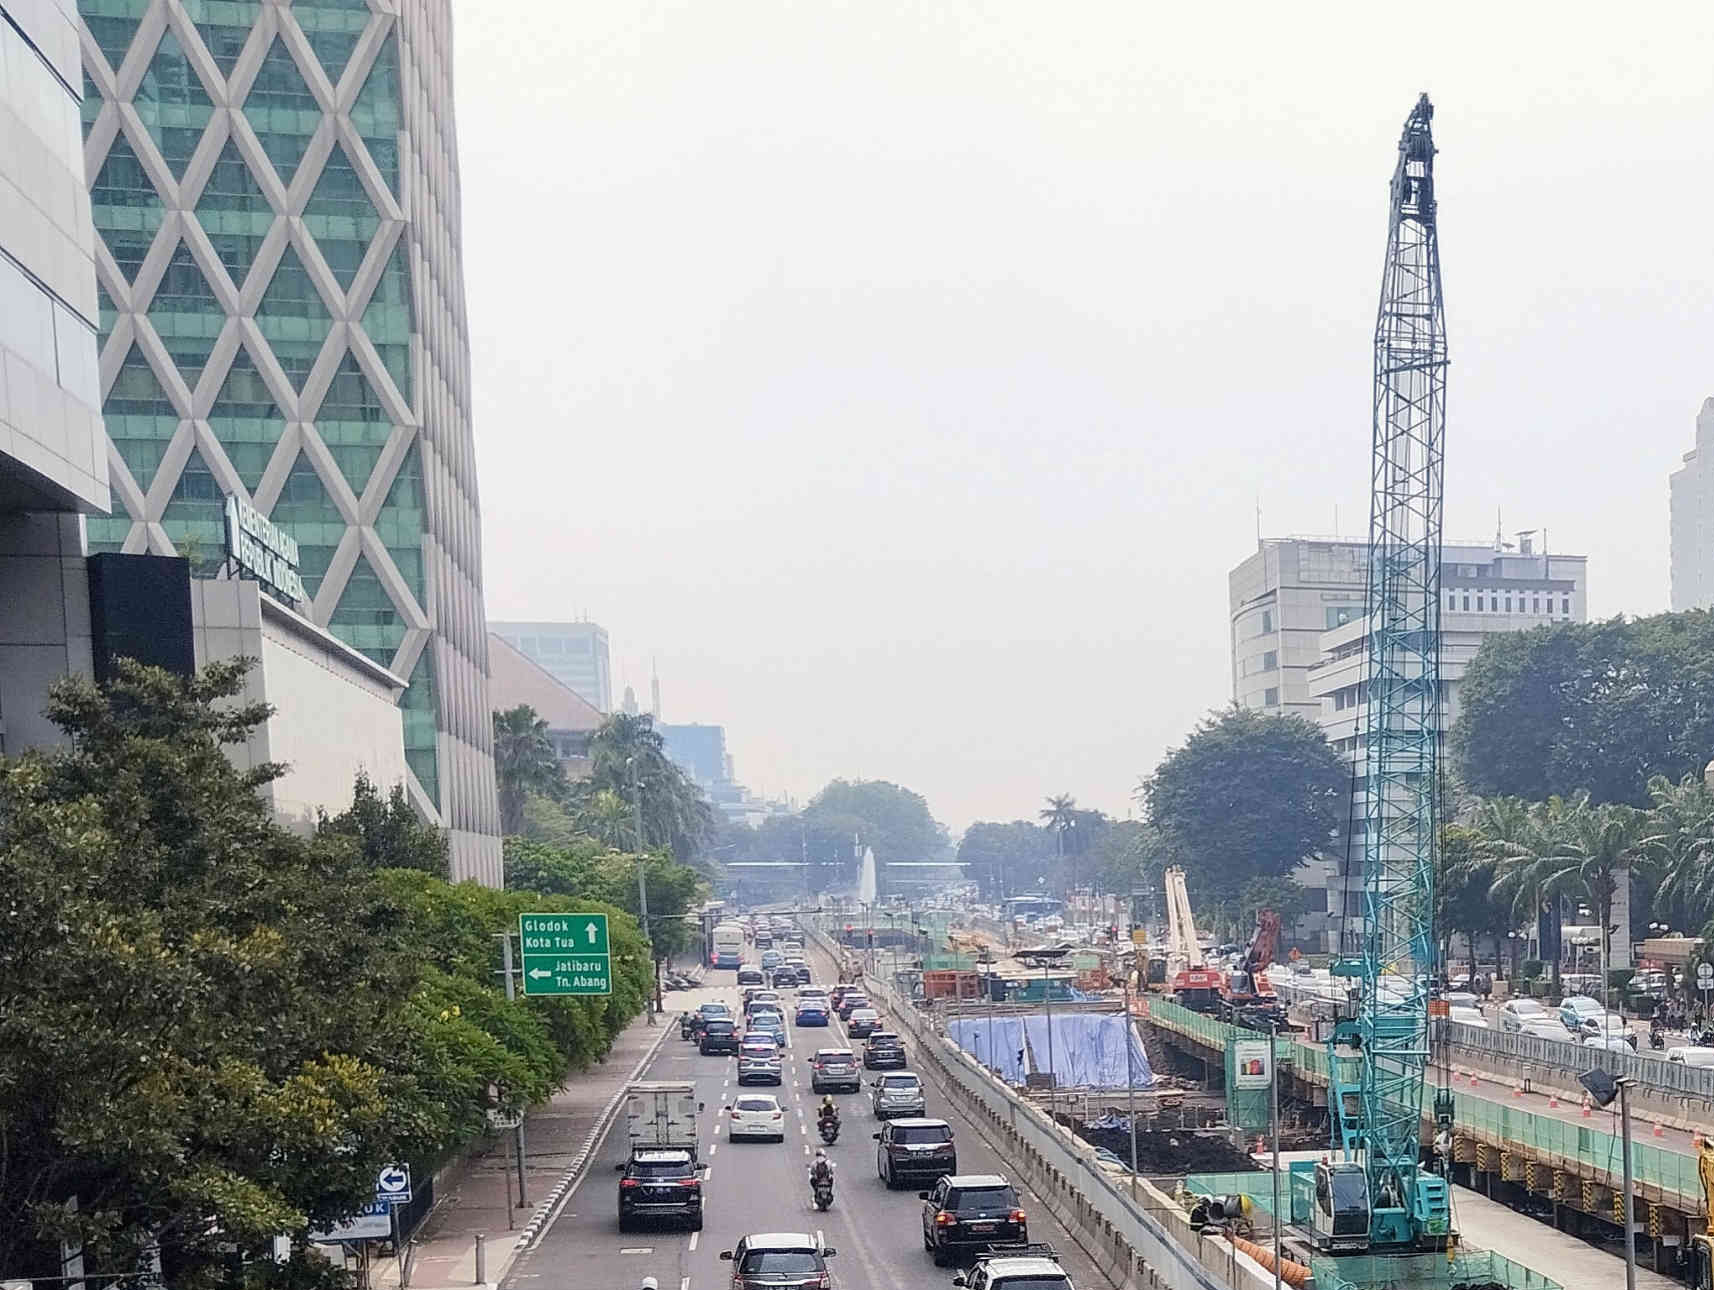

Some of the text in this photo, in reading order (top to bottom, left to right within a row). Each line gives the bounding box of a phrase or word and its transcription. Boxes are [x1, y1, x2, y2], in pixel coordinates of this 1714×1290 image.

[525, 919, 569, 932] Glodok
[526, 937, 575, 948] Kota Tua
[555, 960, 601, 972] Jatibaru
[556, 976, 607, 990] Tn. Abang
